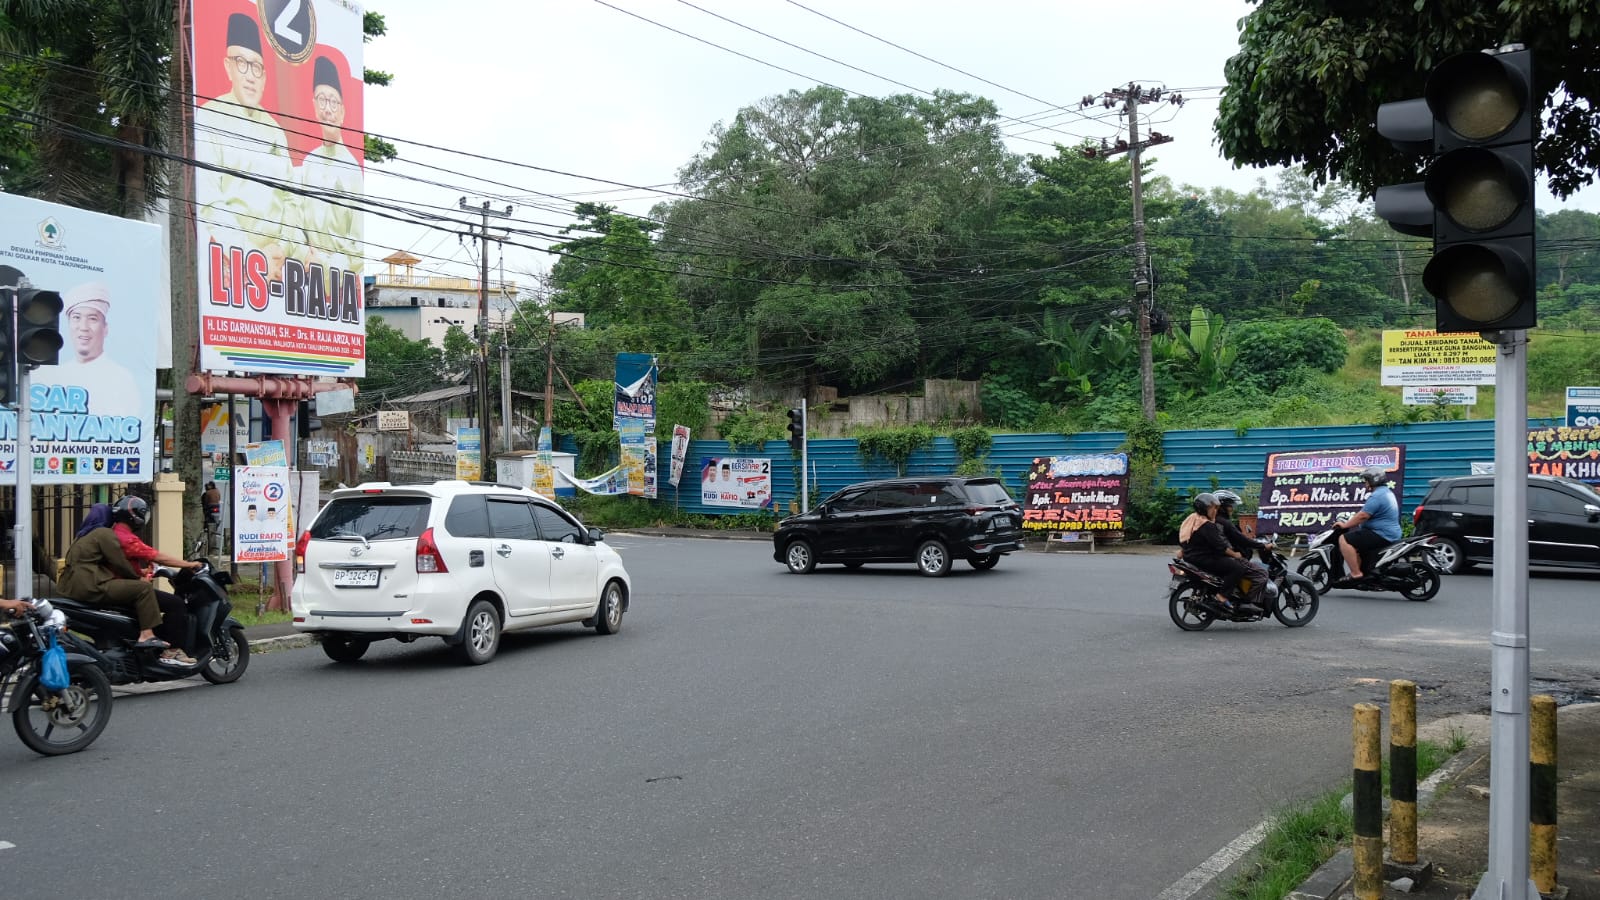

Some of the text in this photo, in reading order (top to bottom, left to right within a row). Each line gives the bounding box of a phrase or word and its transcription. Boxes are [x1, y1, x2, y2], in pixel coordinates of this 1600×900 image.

[10, 245, 34, 254] DEWAN
[35, 250, 63, 260] PIMPINAN
[65, 255, 88, 264] DAERAH
[15, 252, 39, 262] GOLKAR
[41, 257, 57, 265] KOTA
[58, 260, 104, 273] TANJUNGPINANG
[209, 242, 359, 324] LIS-RAJA
[207, 319, 215, 330] H.
[217, 320, 228, 332] LIS
[230, 321, 278, 338] DARMANSYAH,
[297, 330, 309, 341] Drs.
[317, 332, 331, 343] RAJA
[209, 334, 228, 342] CALON
[30, 383, 89, 414] SAR
[30, 445, 49, 454] AJU
[52, 445, 99, 455] MAKMUR
[101, 446, 140, 455] MERATA
[1528, 441, 1546, 452] AS
[761, 462, 769, 474] 2
[1276, 455, 1391, 470] TURUT BERDUKA CITA
[1529, 462, 1563, 477] TAN
[1274, 474, 1366, 486] Atas Meningga
[269, 486, 278, 498] 2
[1054, 491, 1070, 504] Tan
[1289, 488, 1310, 502] Tan
[1310, 487, 1350, 502] Khiok
[1022, 520, 1058, 530] Anggota
[1084, 521, 1108, 530] Kota
[1278, 512, 1332, 527] RUDY
[335, 571, 345, 580] BP
